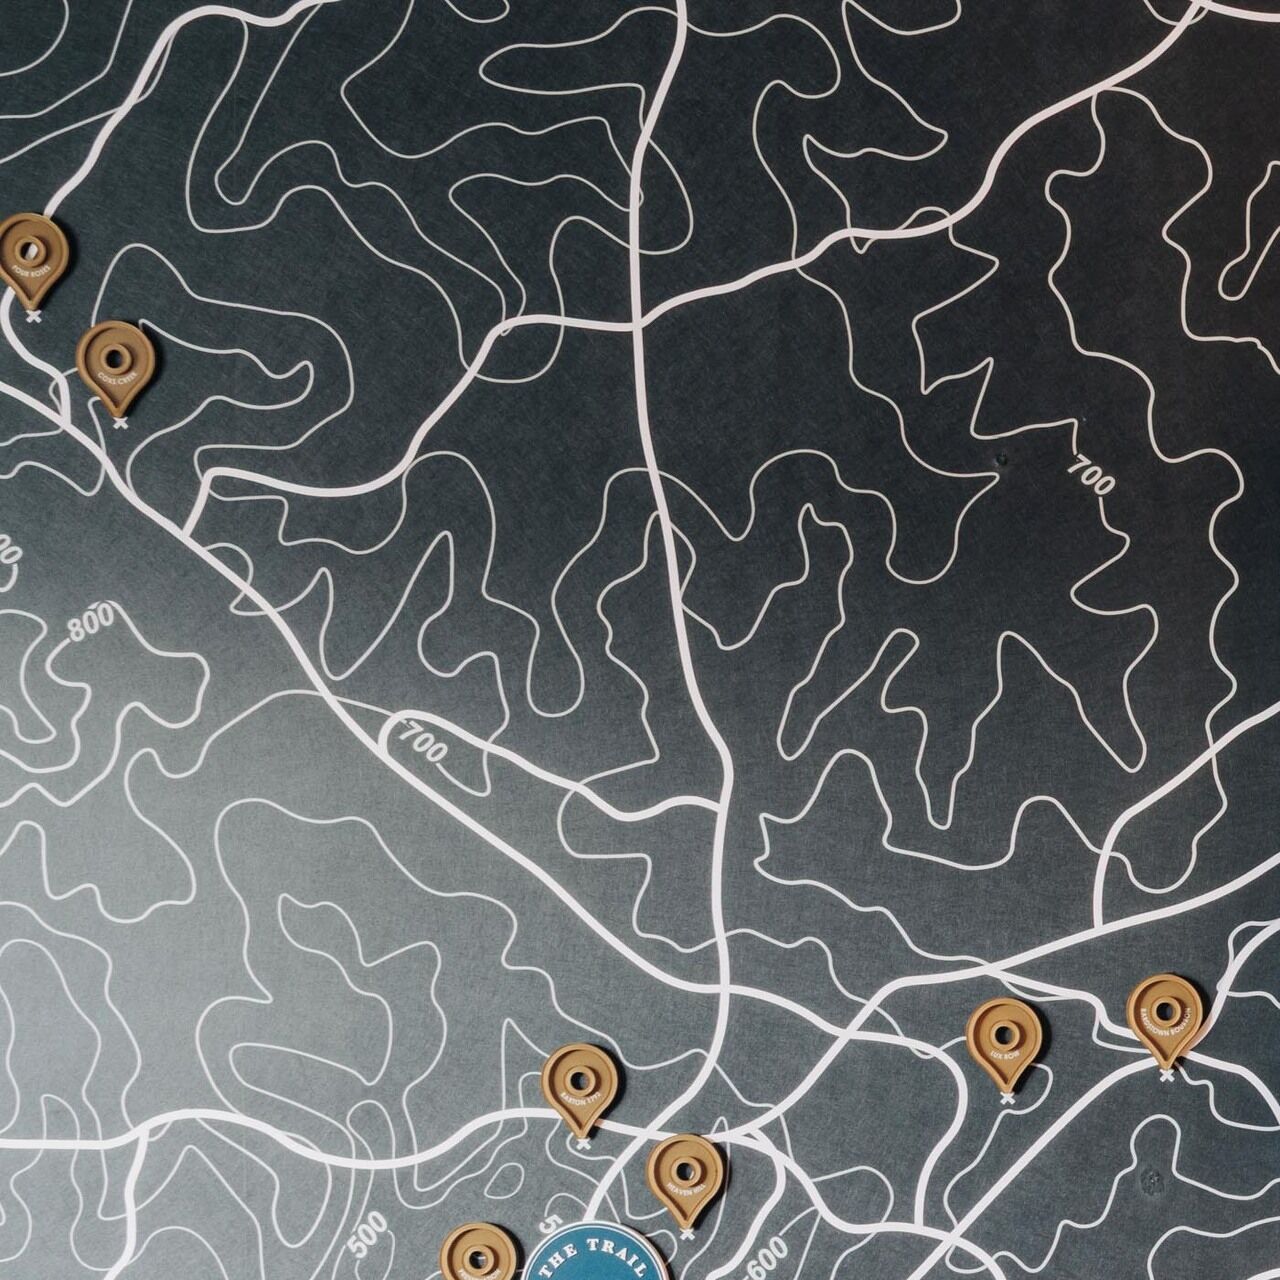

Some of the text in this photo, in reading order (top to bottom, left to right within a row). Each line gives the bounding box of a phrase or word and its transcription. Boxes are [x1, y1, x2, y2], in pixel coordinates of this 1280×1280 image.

[1067, 453, 1116, 497] 700
[67, 603, 114, 642] 800
[399, 720, 448, 763] 700
[347, 1210, 389, 1259] 500
[538, 1238, 648, 1279] THE TRAIL
